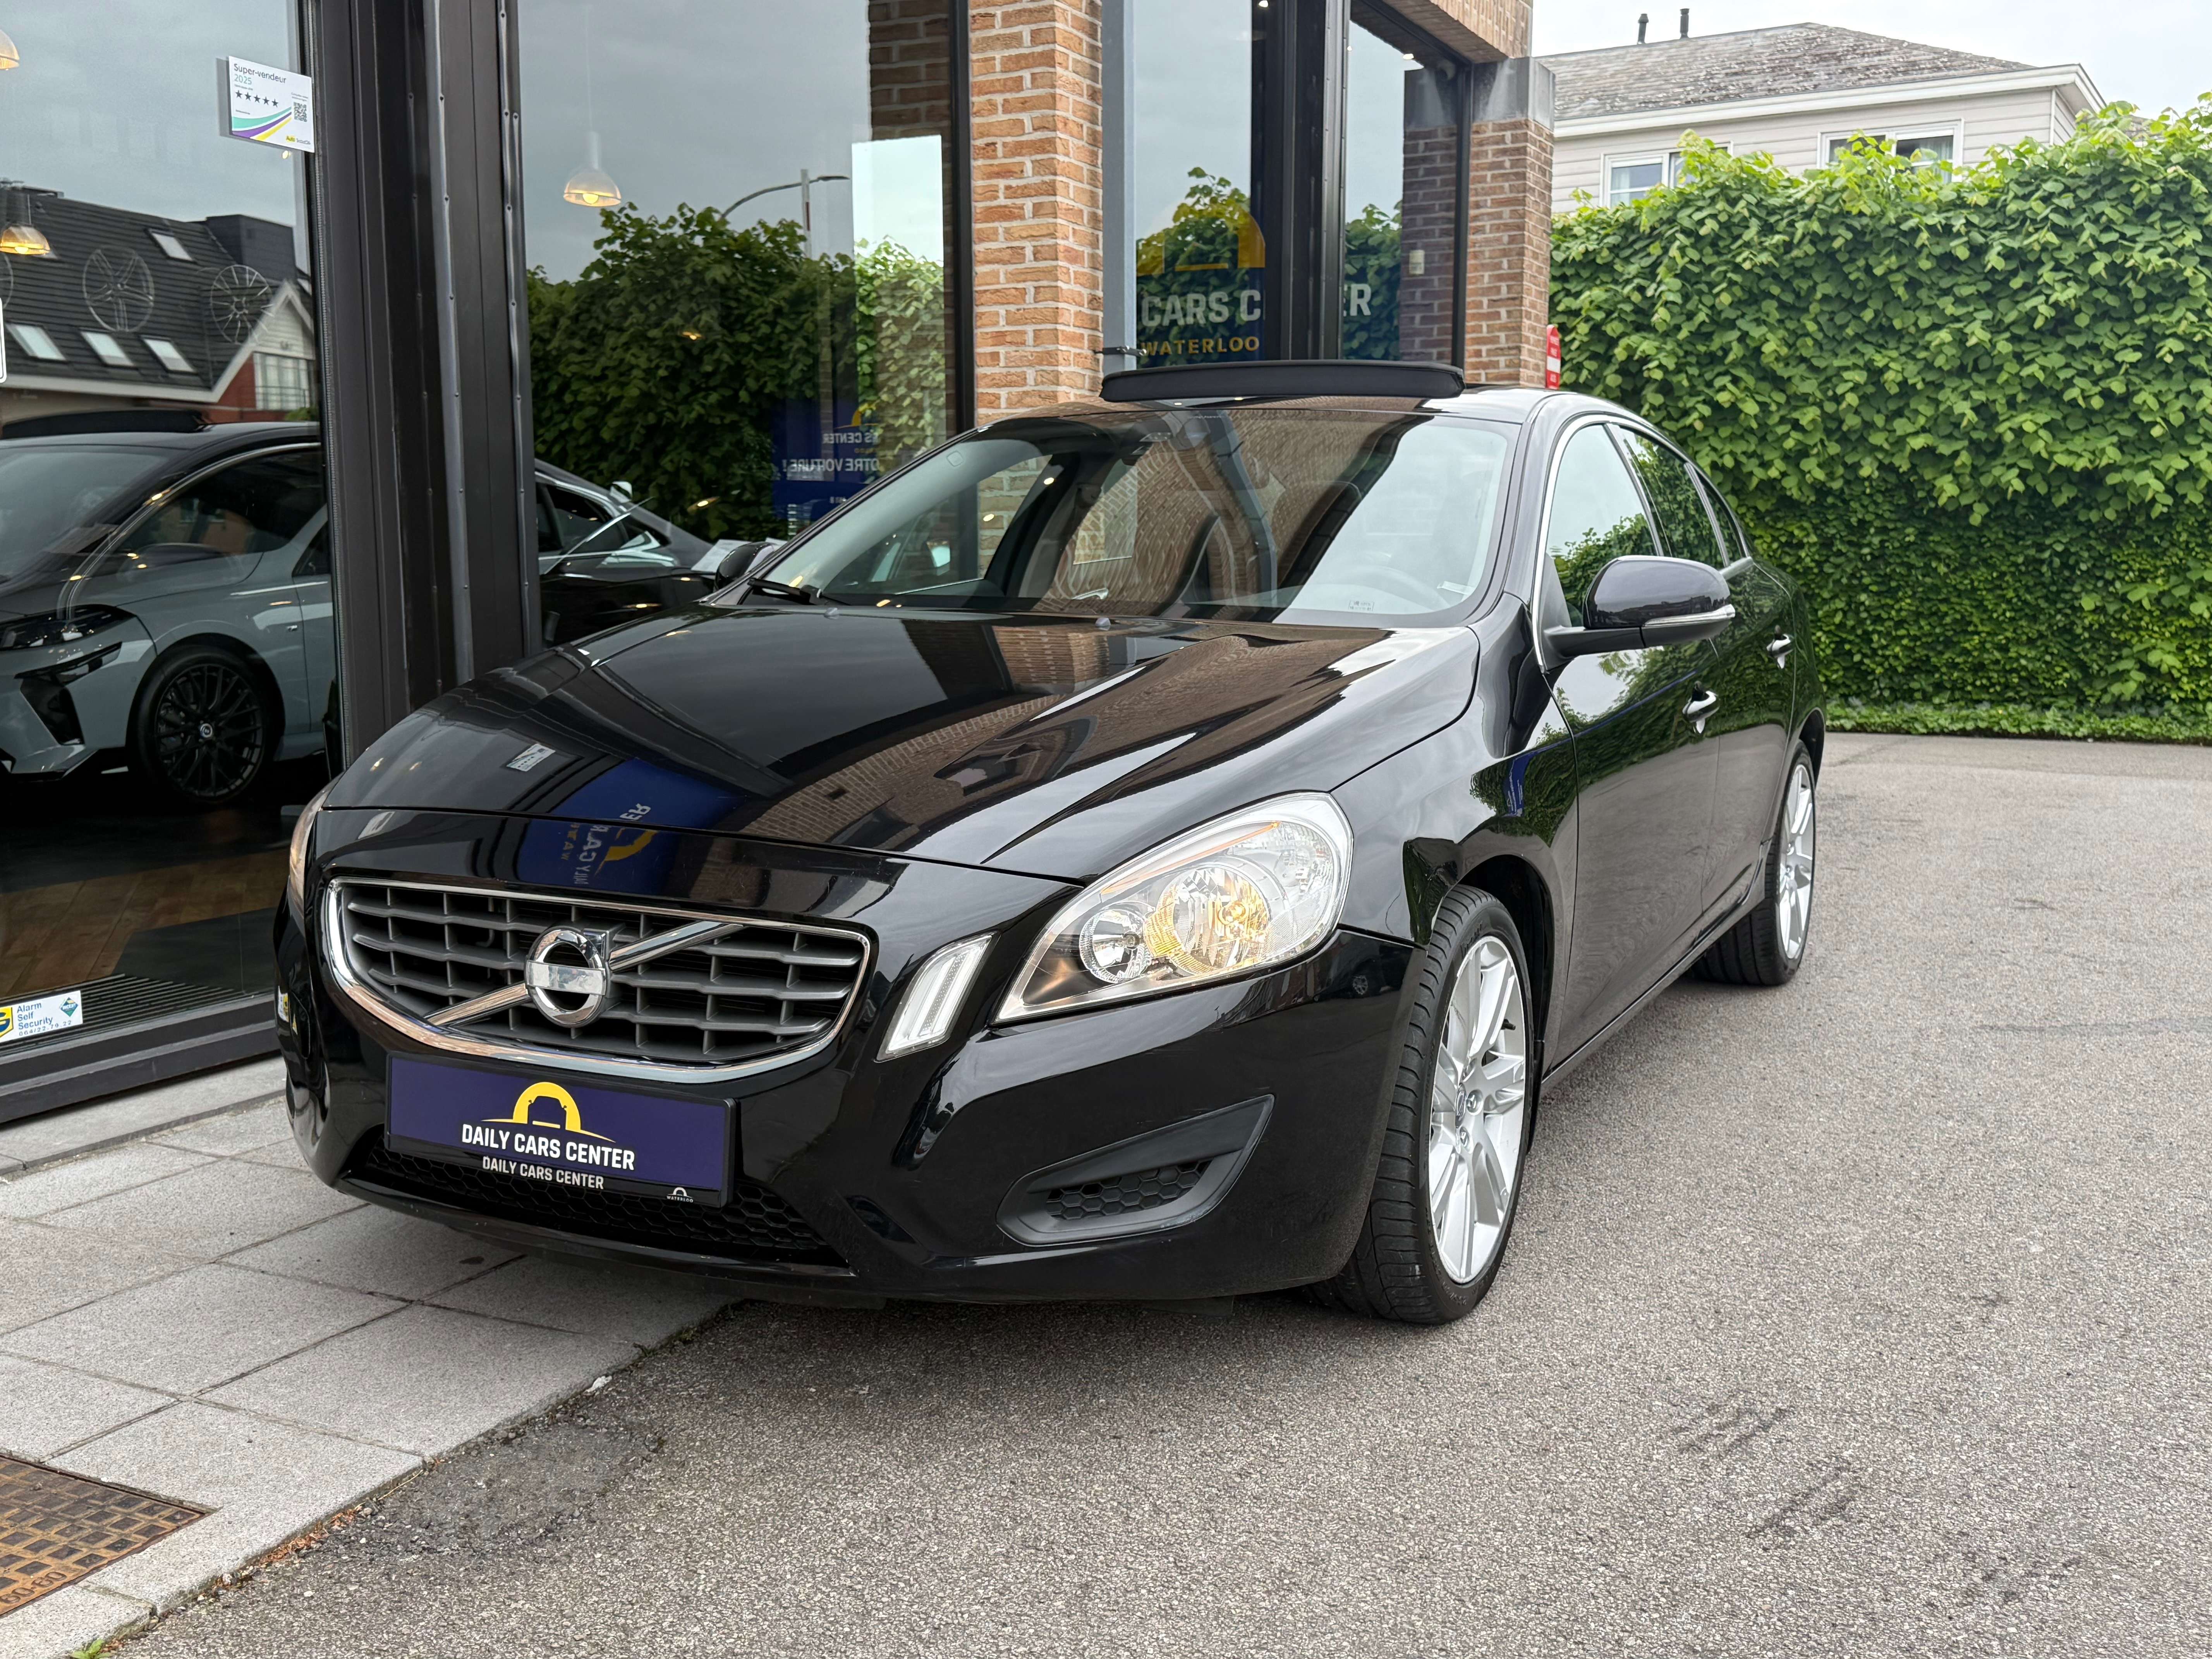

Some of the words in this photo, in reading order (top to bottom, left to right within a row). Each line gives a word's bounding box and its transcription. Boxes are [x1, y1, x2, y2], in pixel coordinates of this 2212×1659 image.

[234, 64, 287, 83] Super-vendeur
[234, 74, 252, 85] 2025
[1141, 292, 1229, 327] CARS
[1140, 337, 1260, 356] WATERLOO
[17, 1002, 42, 1013] Alarm
[17, 1011, 34, 1022] Self
[18, 1017, 53, 1030] Security
[462, 1123, 510, 1150] DAILY
[514, 1133, 561, 1159] CARS
[565, 1141, 635, 1171] CENTER
[482, 1156, 517, 1175] DAILY
[520, 1163, 553, 1181] CARS
[556, 1170, 604, 1190] CENTER
